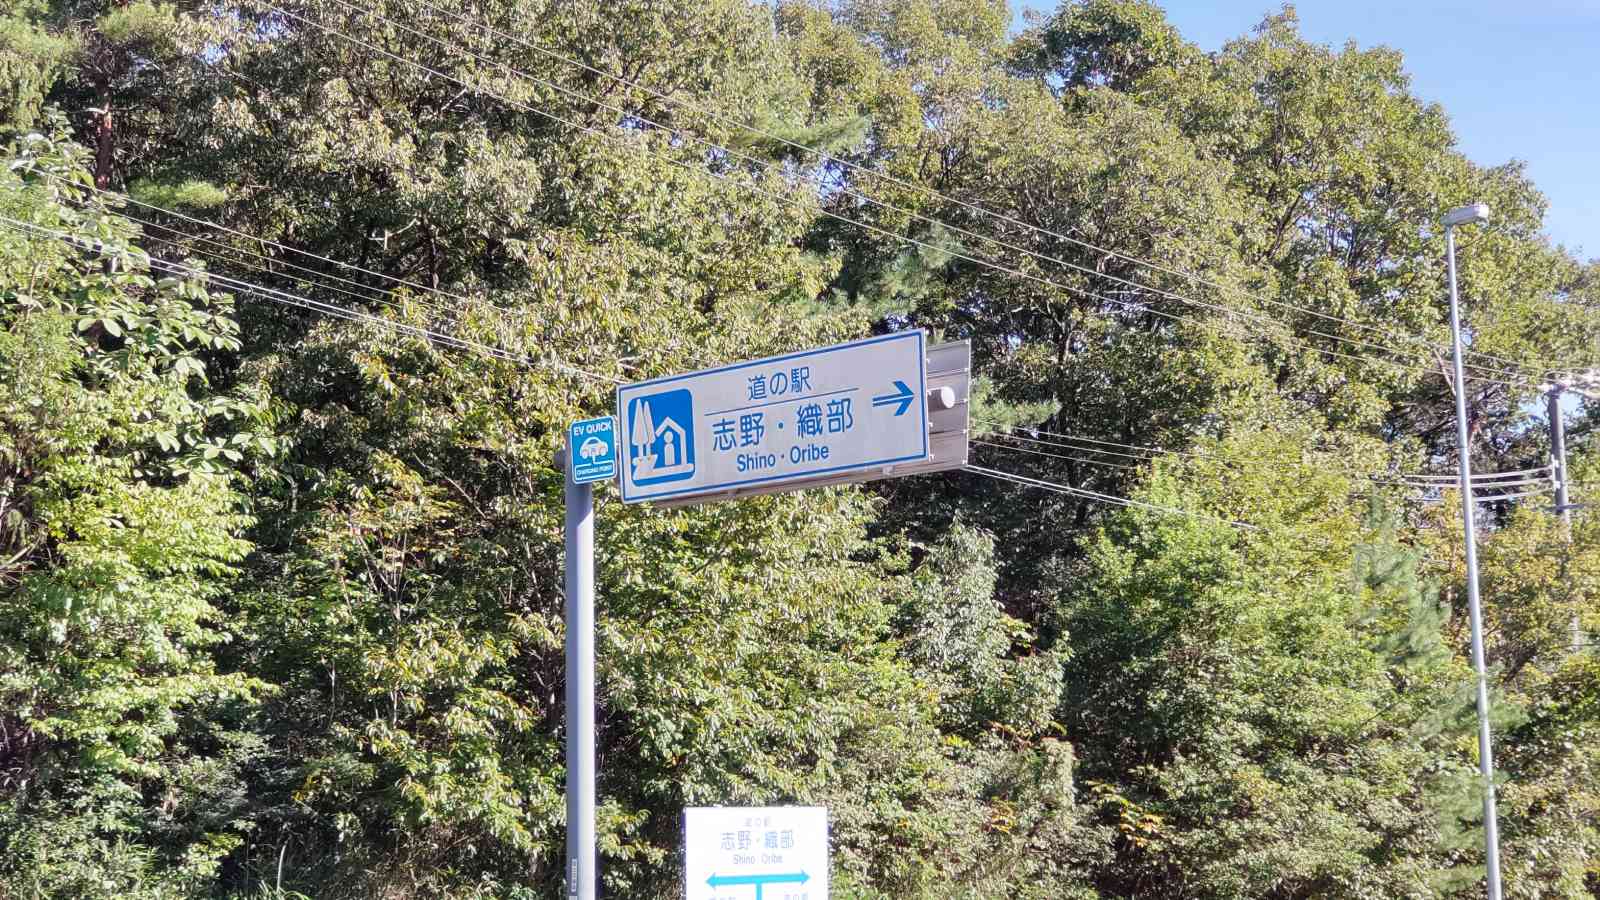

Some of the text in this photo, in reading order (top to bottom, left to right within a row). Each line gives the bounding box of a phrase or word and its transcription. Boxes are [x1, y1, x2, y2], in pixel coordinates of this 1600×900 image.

[748, 366, 812, 401] 道の駅
[573, 421, 612, 437] EV QUICK
[712, 398, 854, 452] 志野・織部
[736, 452, 776, 472] Shino
[790, 444, 829, 464] Oribe
